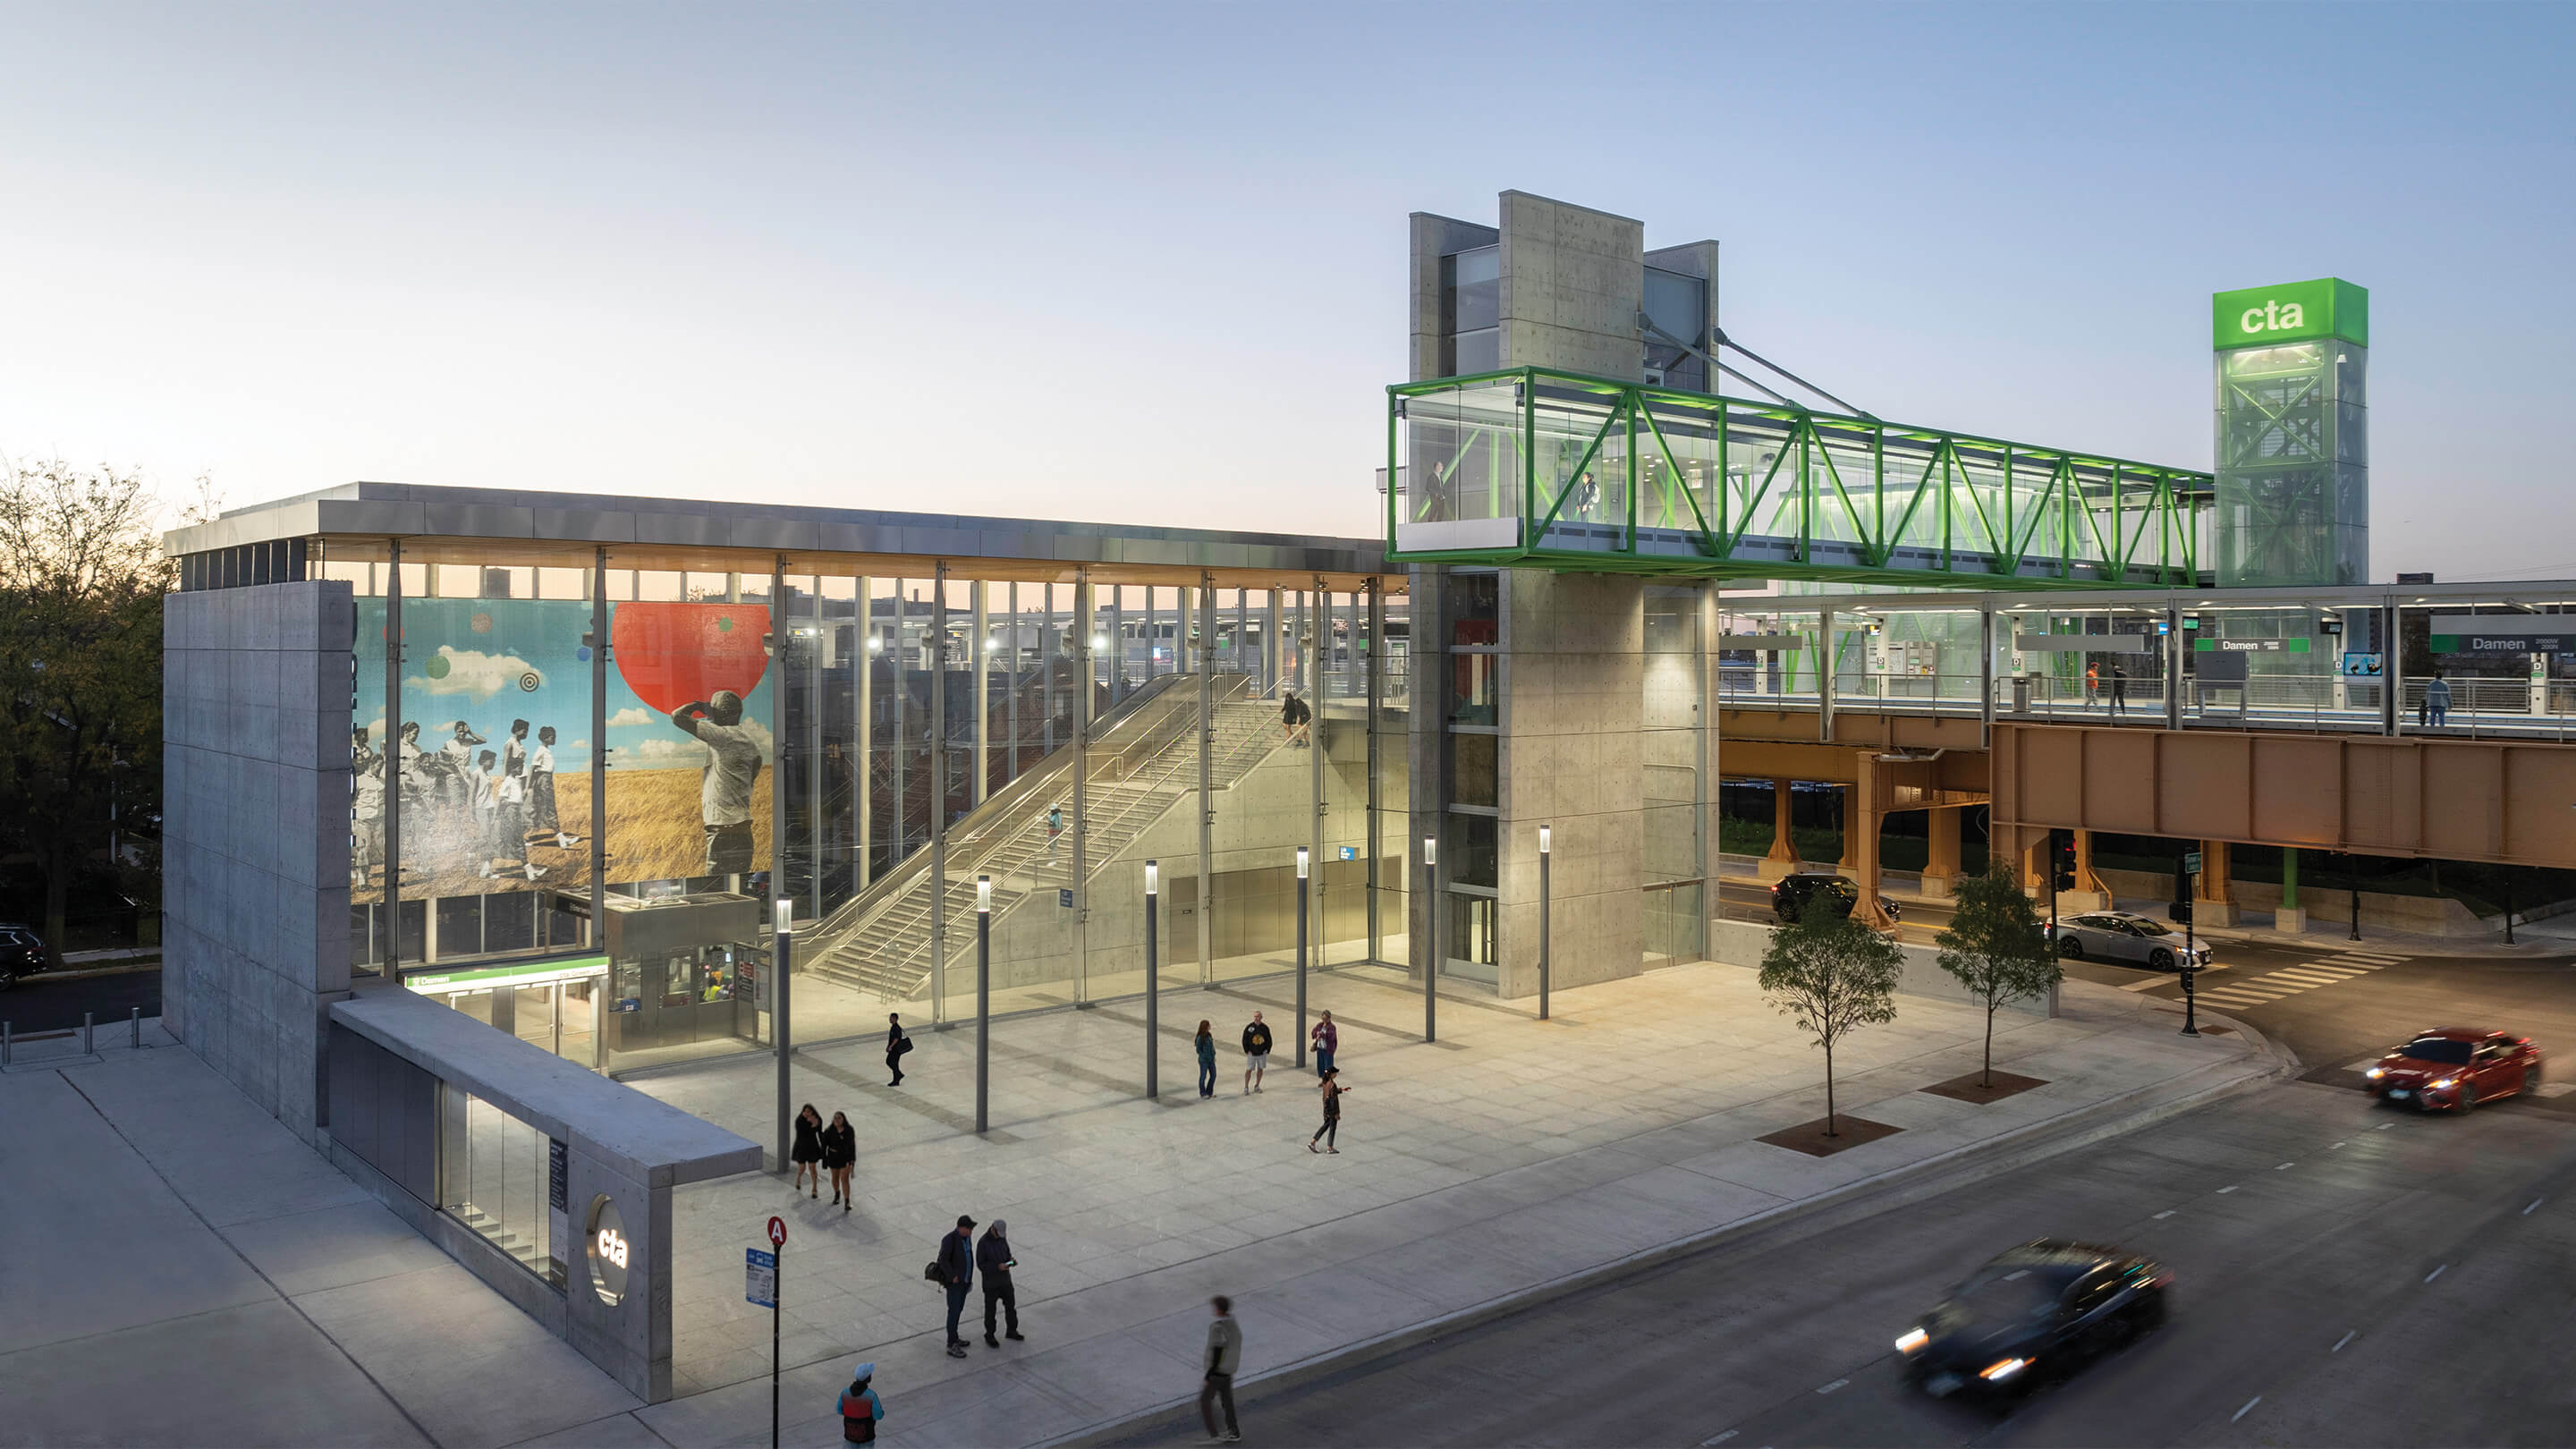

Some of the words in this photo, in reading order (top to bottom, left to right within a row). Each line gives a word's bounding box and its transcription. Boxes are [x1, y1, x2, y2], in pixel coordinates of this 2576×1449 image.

[2241, 301, 2304, 334] cta
[2222, 640, 2258, 650] Damen
[2472, 638, 2526, 650] Damen
[771, 1220, 784, 1242] A
[597, 1228, 629, 1270] cta
